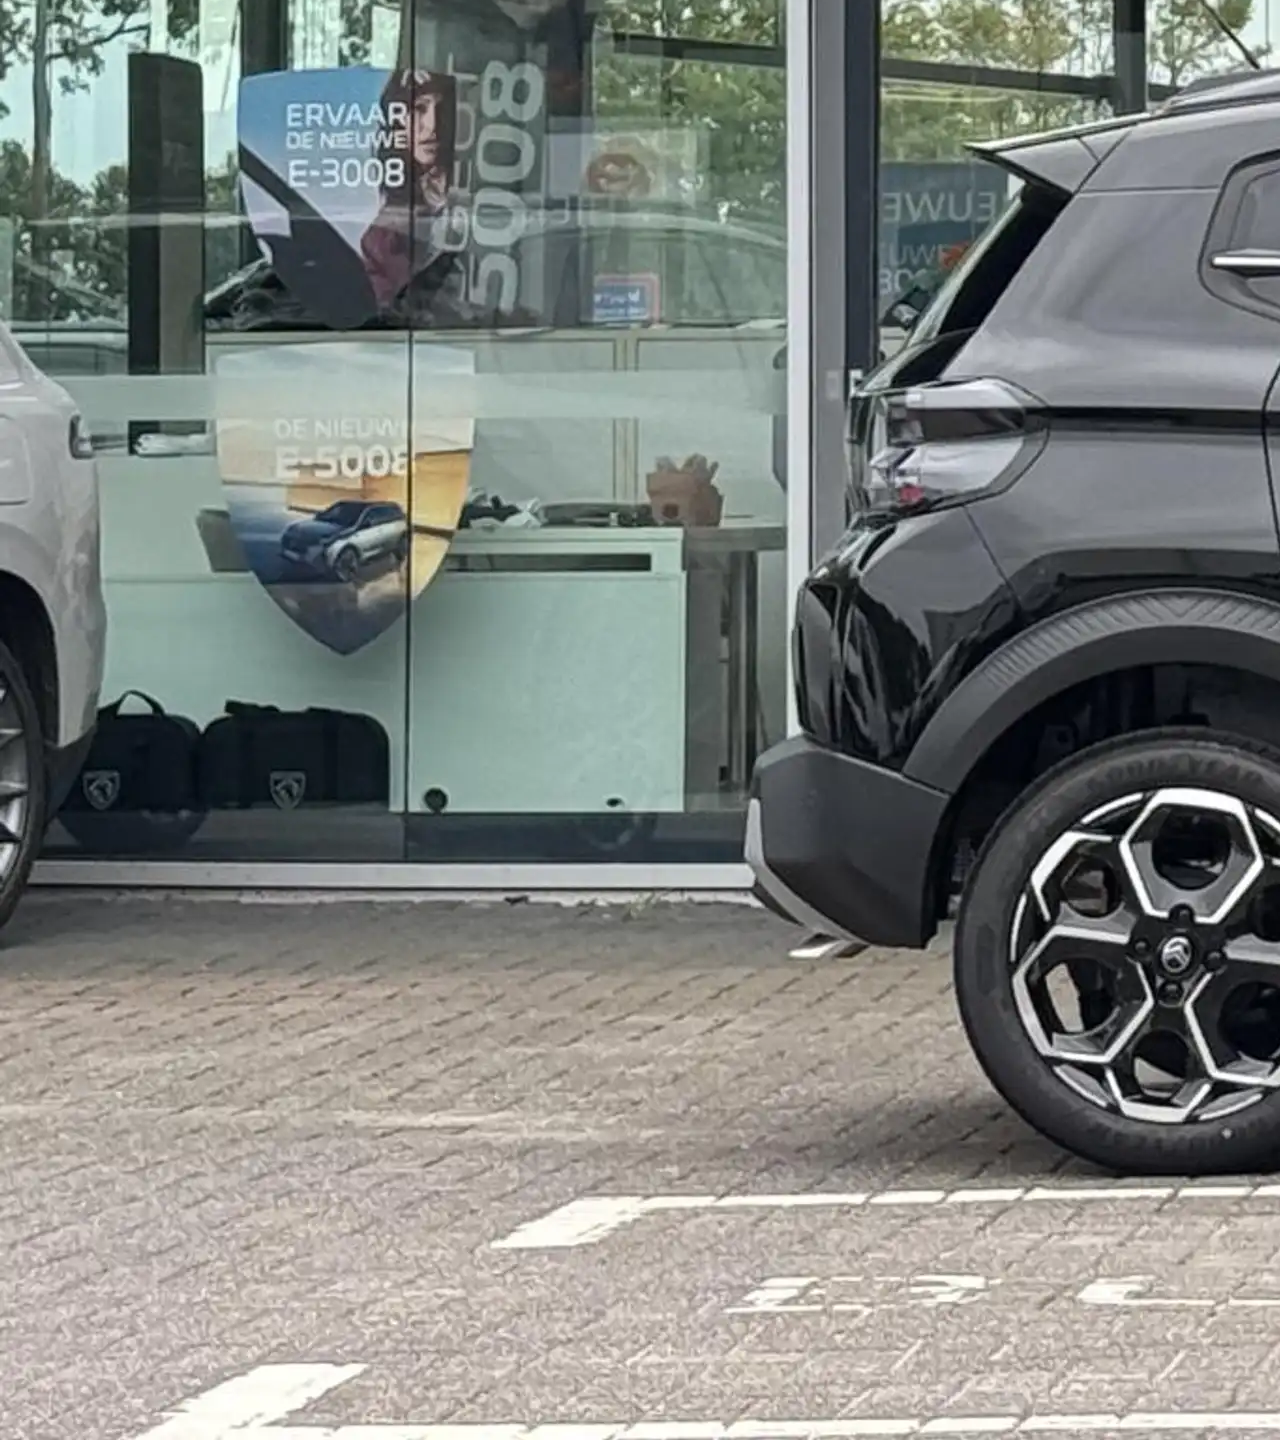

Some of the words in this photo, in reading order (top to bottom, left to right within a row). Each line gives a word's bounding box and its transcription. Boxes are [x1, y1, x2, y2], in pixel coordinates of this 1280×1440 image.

[286, 102, 408, 128] ERVAAR
[285, 131, 315, 150] DE
[319, 131, 408, 150] NIEUWE
[287, 157, 406, 189] E-3008
[469, 60, 545, 315] 5008
[273, 417, 308, 440] DE
